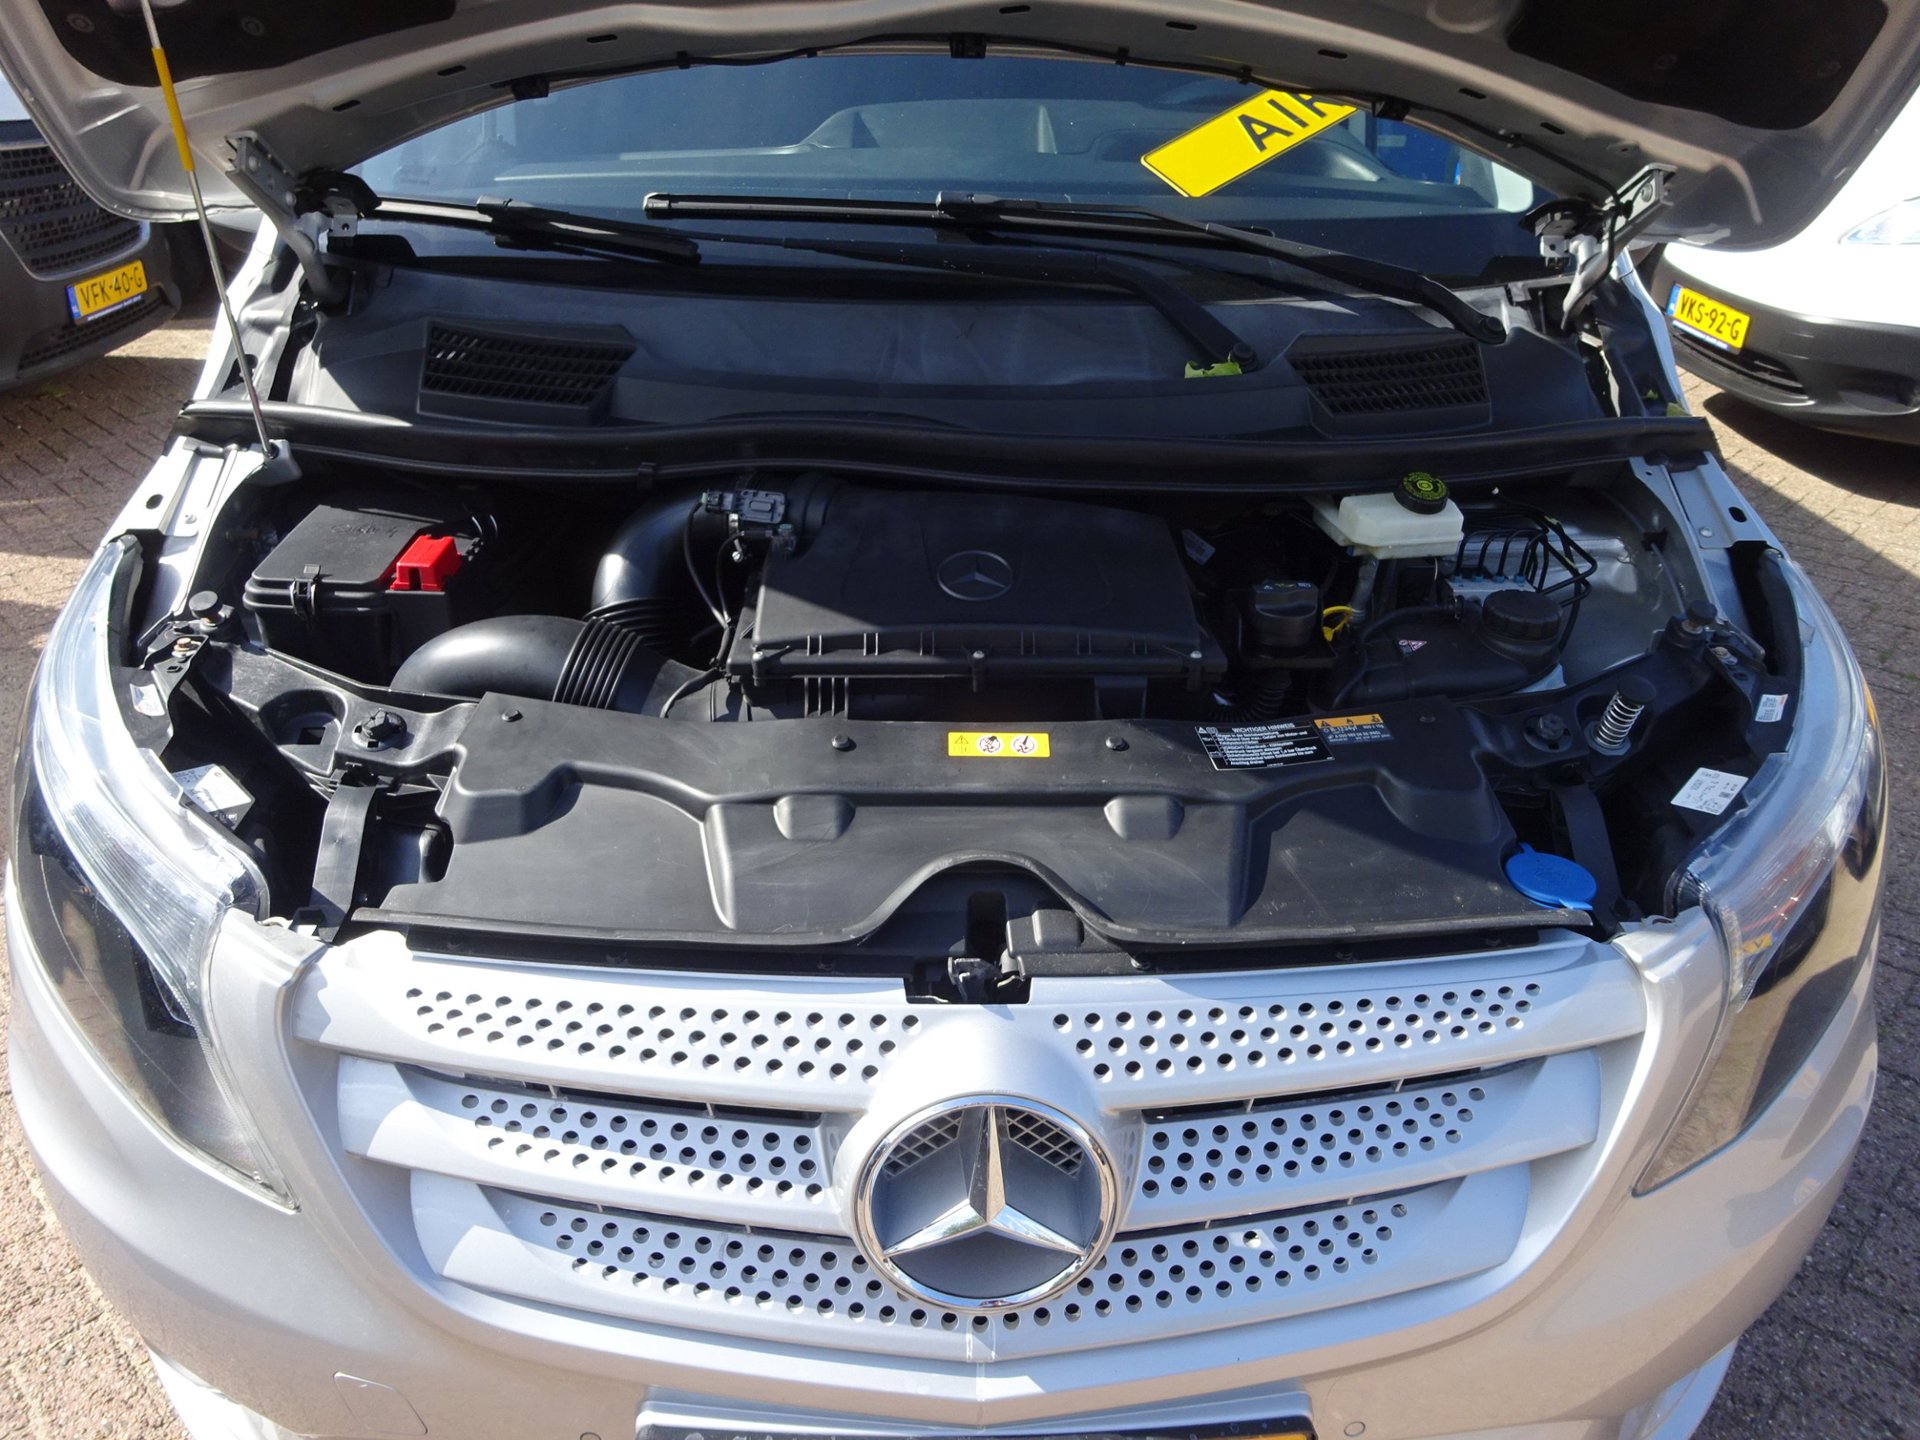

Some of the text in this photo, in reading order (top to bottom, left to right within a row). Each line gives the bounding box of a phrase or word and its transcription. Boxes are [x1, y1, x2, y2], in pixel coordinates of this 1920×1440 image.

[80, 266, 143, 308] VFK-40-G
[1681, 293, 1742, 340] VKS-92-G
[1231, 722, 1295, 733] WICHTIGER HINWEIS
